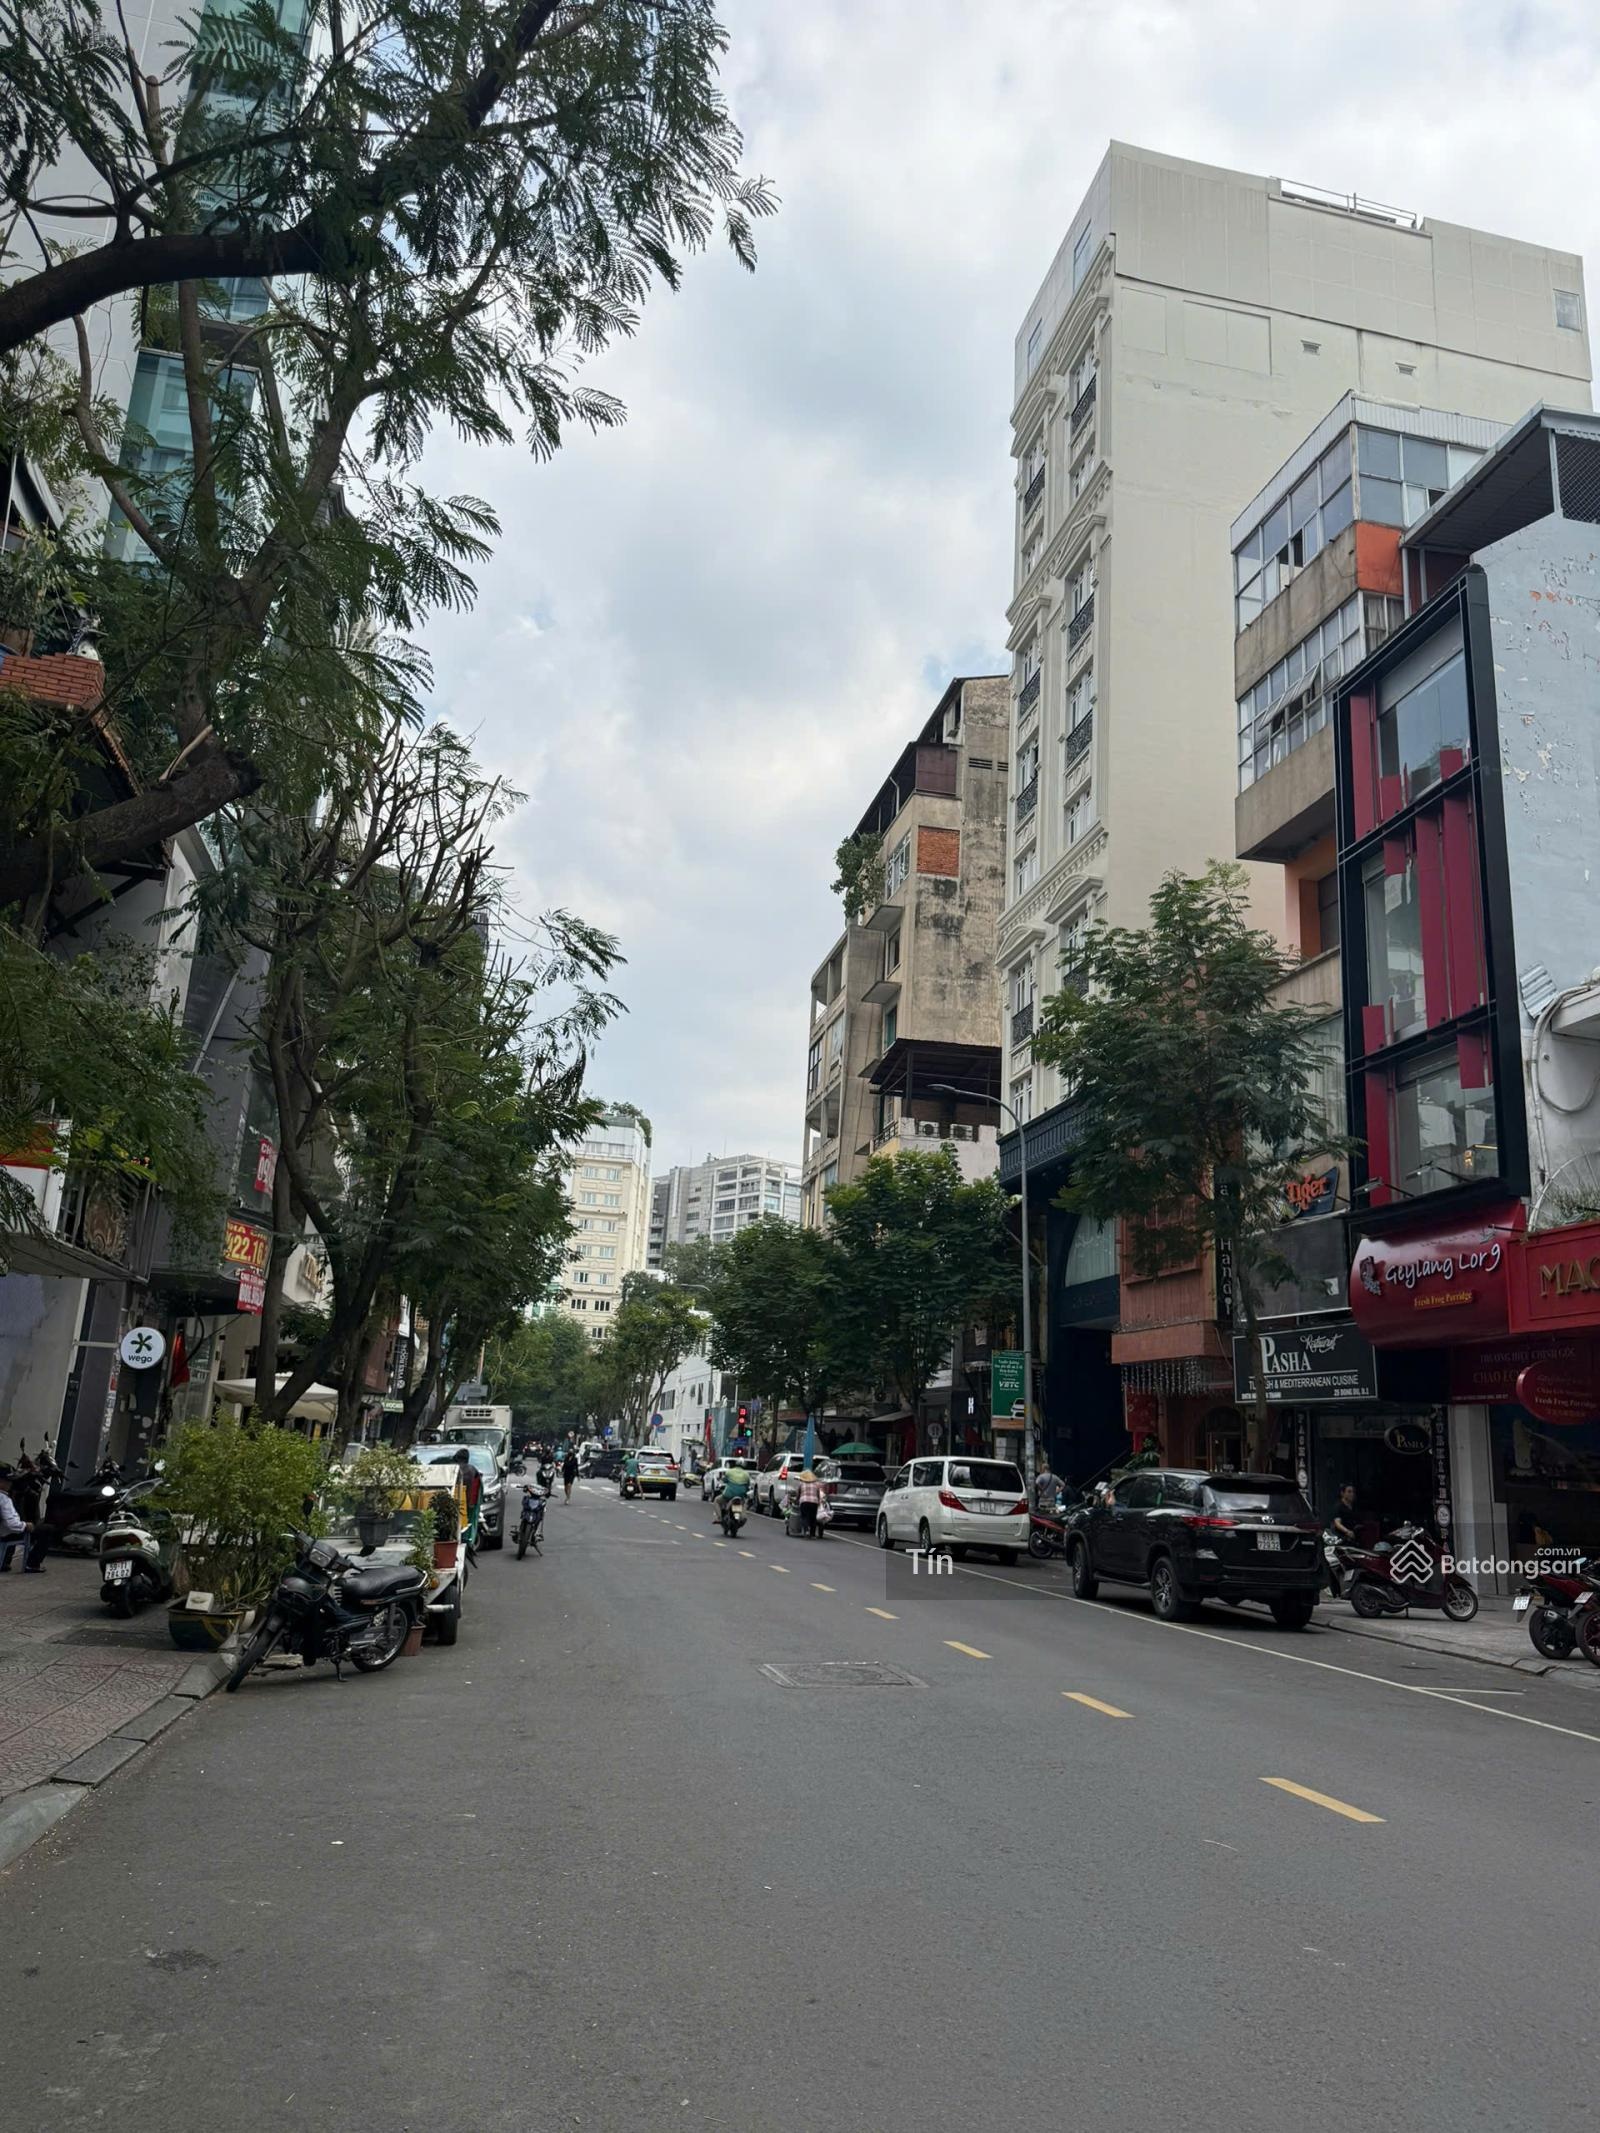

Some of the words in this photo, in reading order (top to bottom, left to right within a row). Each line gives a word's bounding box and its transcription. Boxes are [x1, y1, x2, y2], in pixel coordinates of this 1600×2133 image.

[1285, 1174, 1328, 1210] Tiger
[1385, 1256, 1453, 1288] Geylang
[1458, 1253, 1487, 1270] Lor
[1414, 1297, 1430, 1307] Fresh
[1431, 1295, 1445, 1306] Frog
[1446, 1291, 1473, 1303] Porridge
[128, 1354, 152, 1363] wego
[1259, 1336, 1312, 1374] PASHA
[1279, 1376, 1331, 1389] MEDITERRANEAN
[1332, 1374, 1359, 1386] CUISINE
[1396, 1429, 1424, 1448] PASHA
